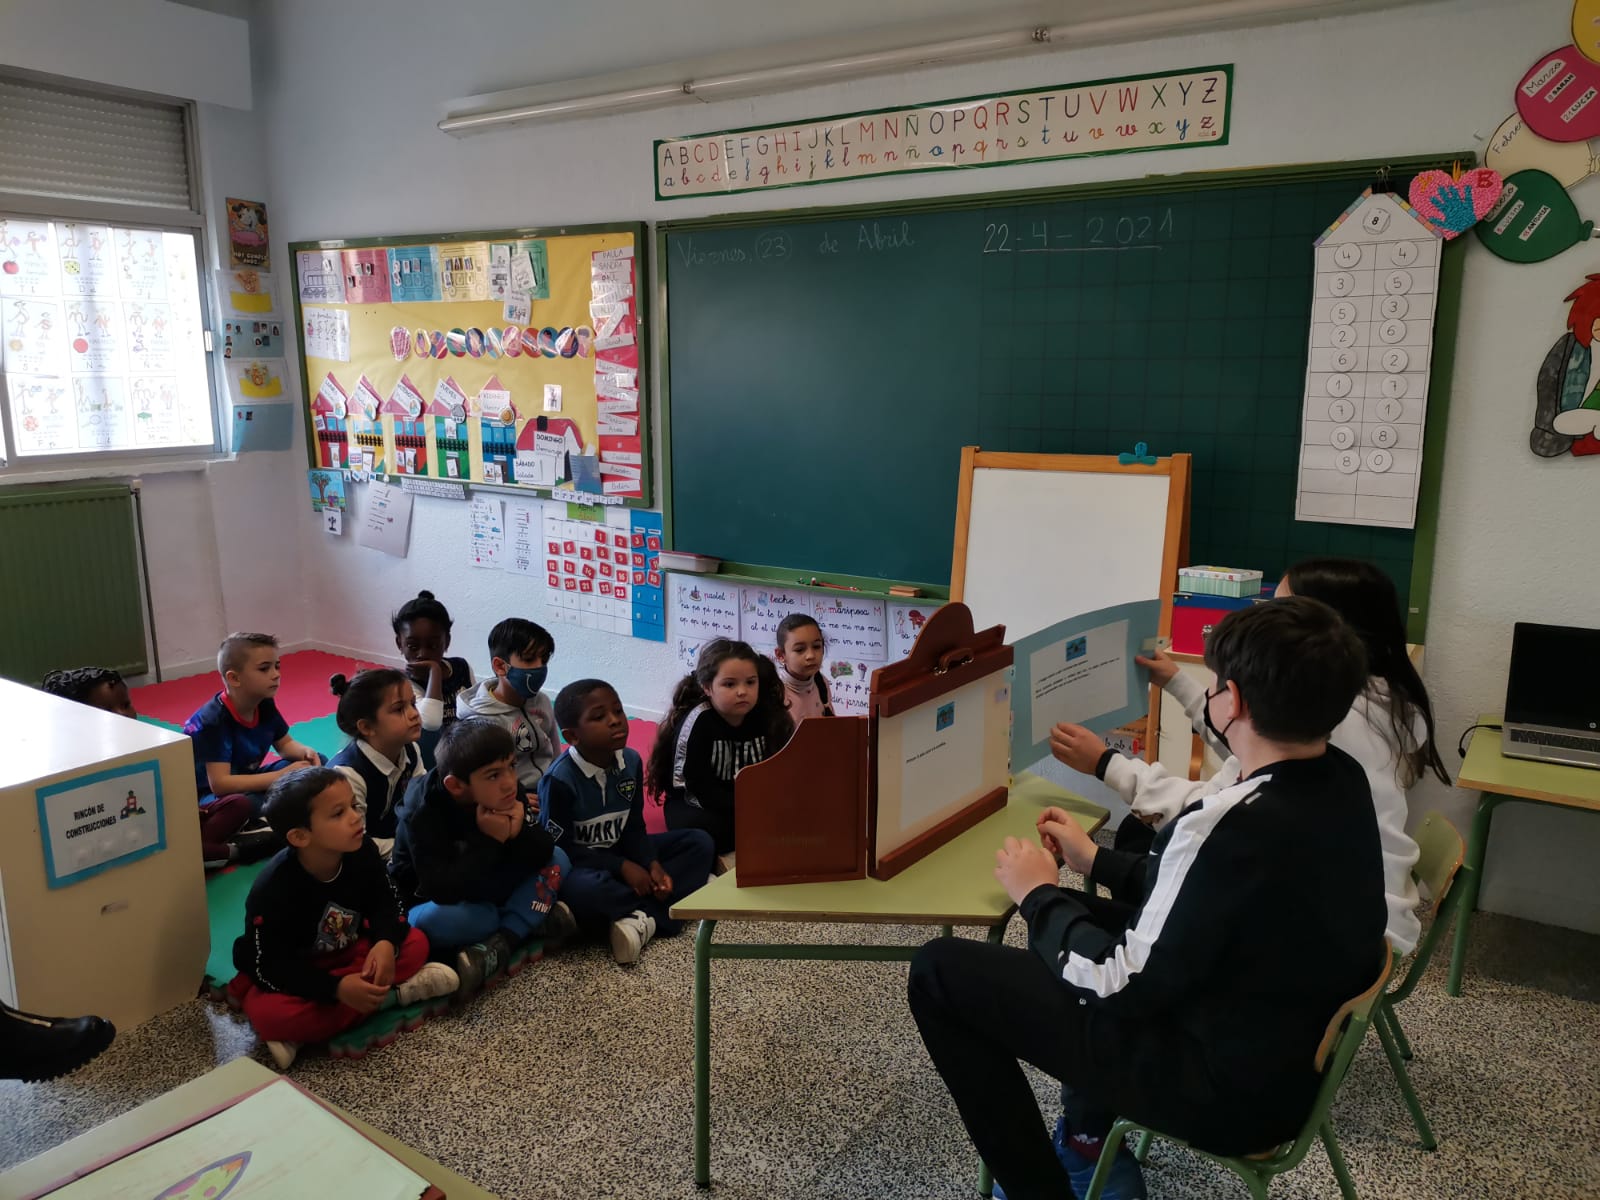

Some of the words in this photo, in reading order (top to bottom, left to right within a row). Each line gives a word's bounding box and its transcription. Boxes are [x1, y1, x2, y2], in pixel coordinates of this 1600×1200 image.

[1371, 216, 1380, 226] 8
[857, 220, 915, 250] Abril
[1342, 250, 1351, 259] 4
[1399, 248, 1406, 259] 4
[1337, 278, 1345, 290] 3
[1393, 277, 1402, 288] 5
[1338, 308, 1346, 320] 5
[1389, 301, 1397, 313] 3
[1338, 330, 1346, 343] 2
[1387, 325, 1395, 336] 6
[1338, 354, 1346, 365] 6
[1390, 354, 1399, 366] 2
[1335, 380, 1341, 390] 1
[1390, 380, 1397, 392] 7
[1336, 405, 1344, 416] 7
[1384, 403, 1391, 416] 1
[1337, 432, 1346, 443] 0
[1378, 430, 1387, 441] 8
[1343, 456, 1351, 467] 8
[1374, 455, 1383, 466] 0
[770, 593, 795, 604] leche
[828, 606, 870, 619] mariposa
[73, 806, 97, 821] RINCÓN
[96, 803, 105, 814] DE
[65, 815, 117, 840] CONSTRUCCIONES
